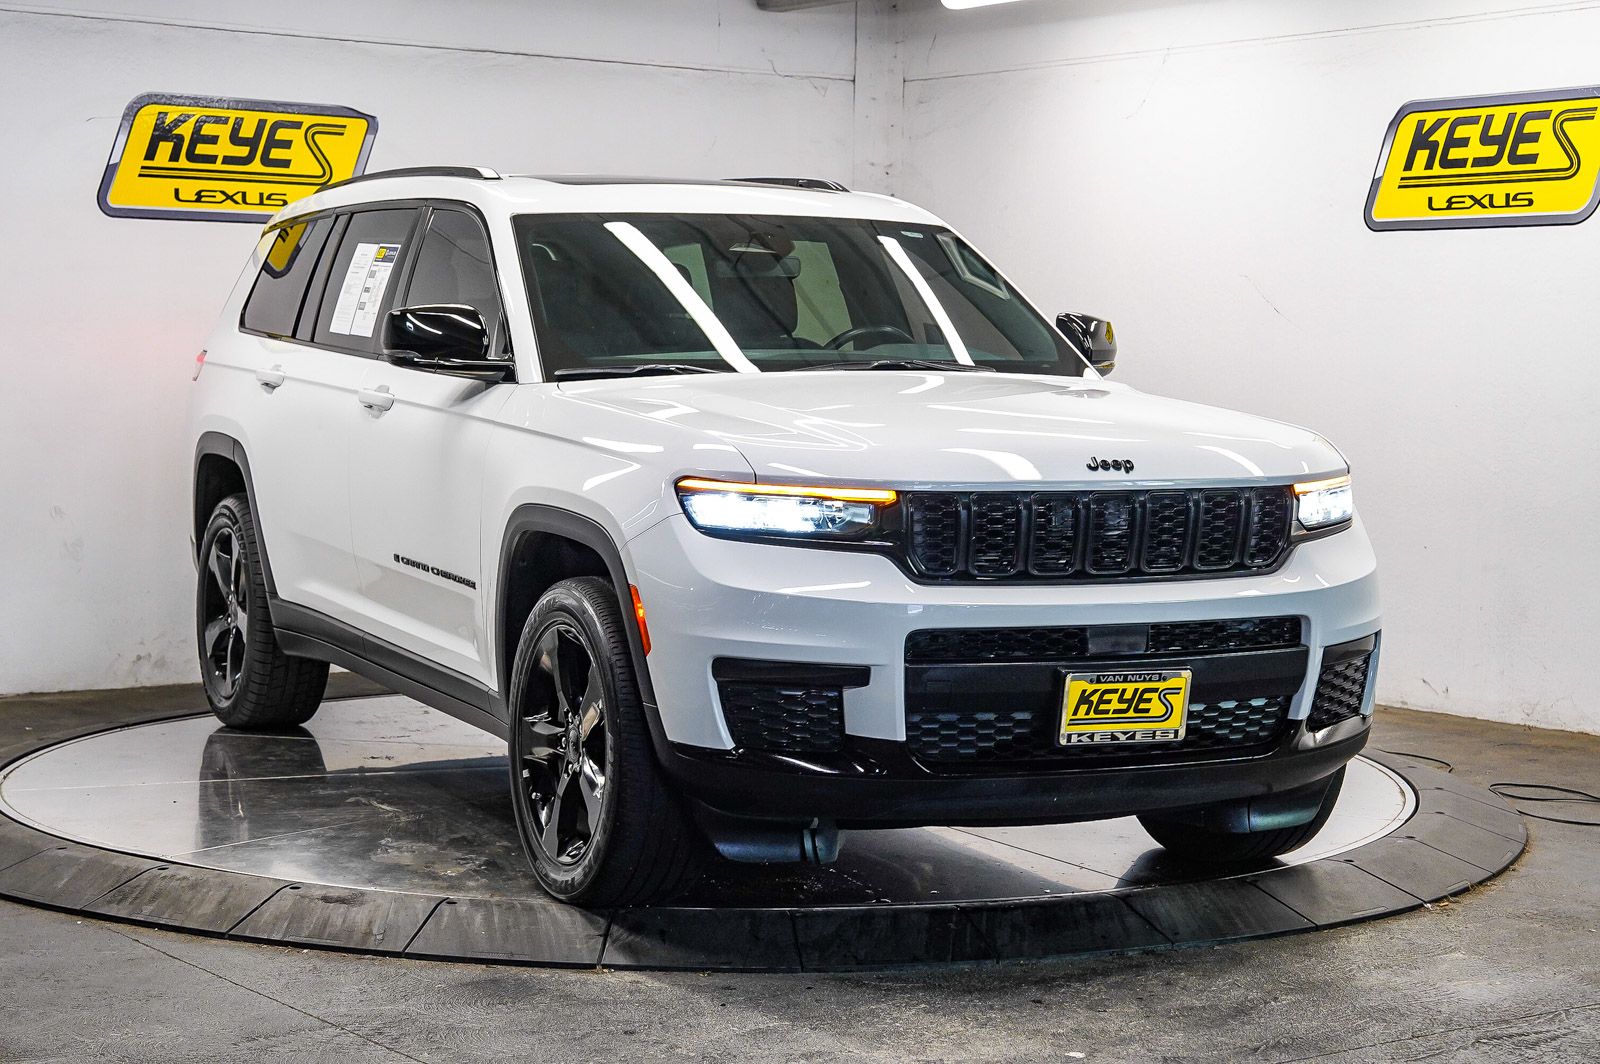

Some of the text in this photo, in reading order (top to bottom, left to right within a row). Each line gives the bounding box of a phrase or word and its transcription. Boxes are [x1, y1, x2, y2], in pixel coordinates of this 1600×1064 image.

[138, 111, 347, 186] KEYES
[1398, 107, 1598, 189] KEYES
[174, 188, 289, 207] LEXUS
[1427, 191, 1534, 211] LEXUS
[1086, 456, 1135, 474] Jeep
[1127, 674, 1160, 682] NUYS
[1067, 687, 1183, 726] KEYES
[1070, 730, 1175, 743] KEYES
